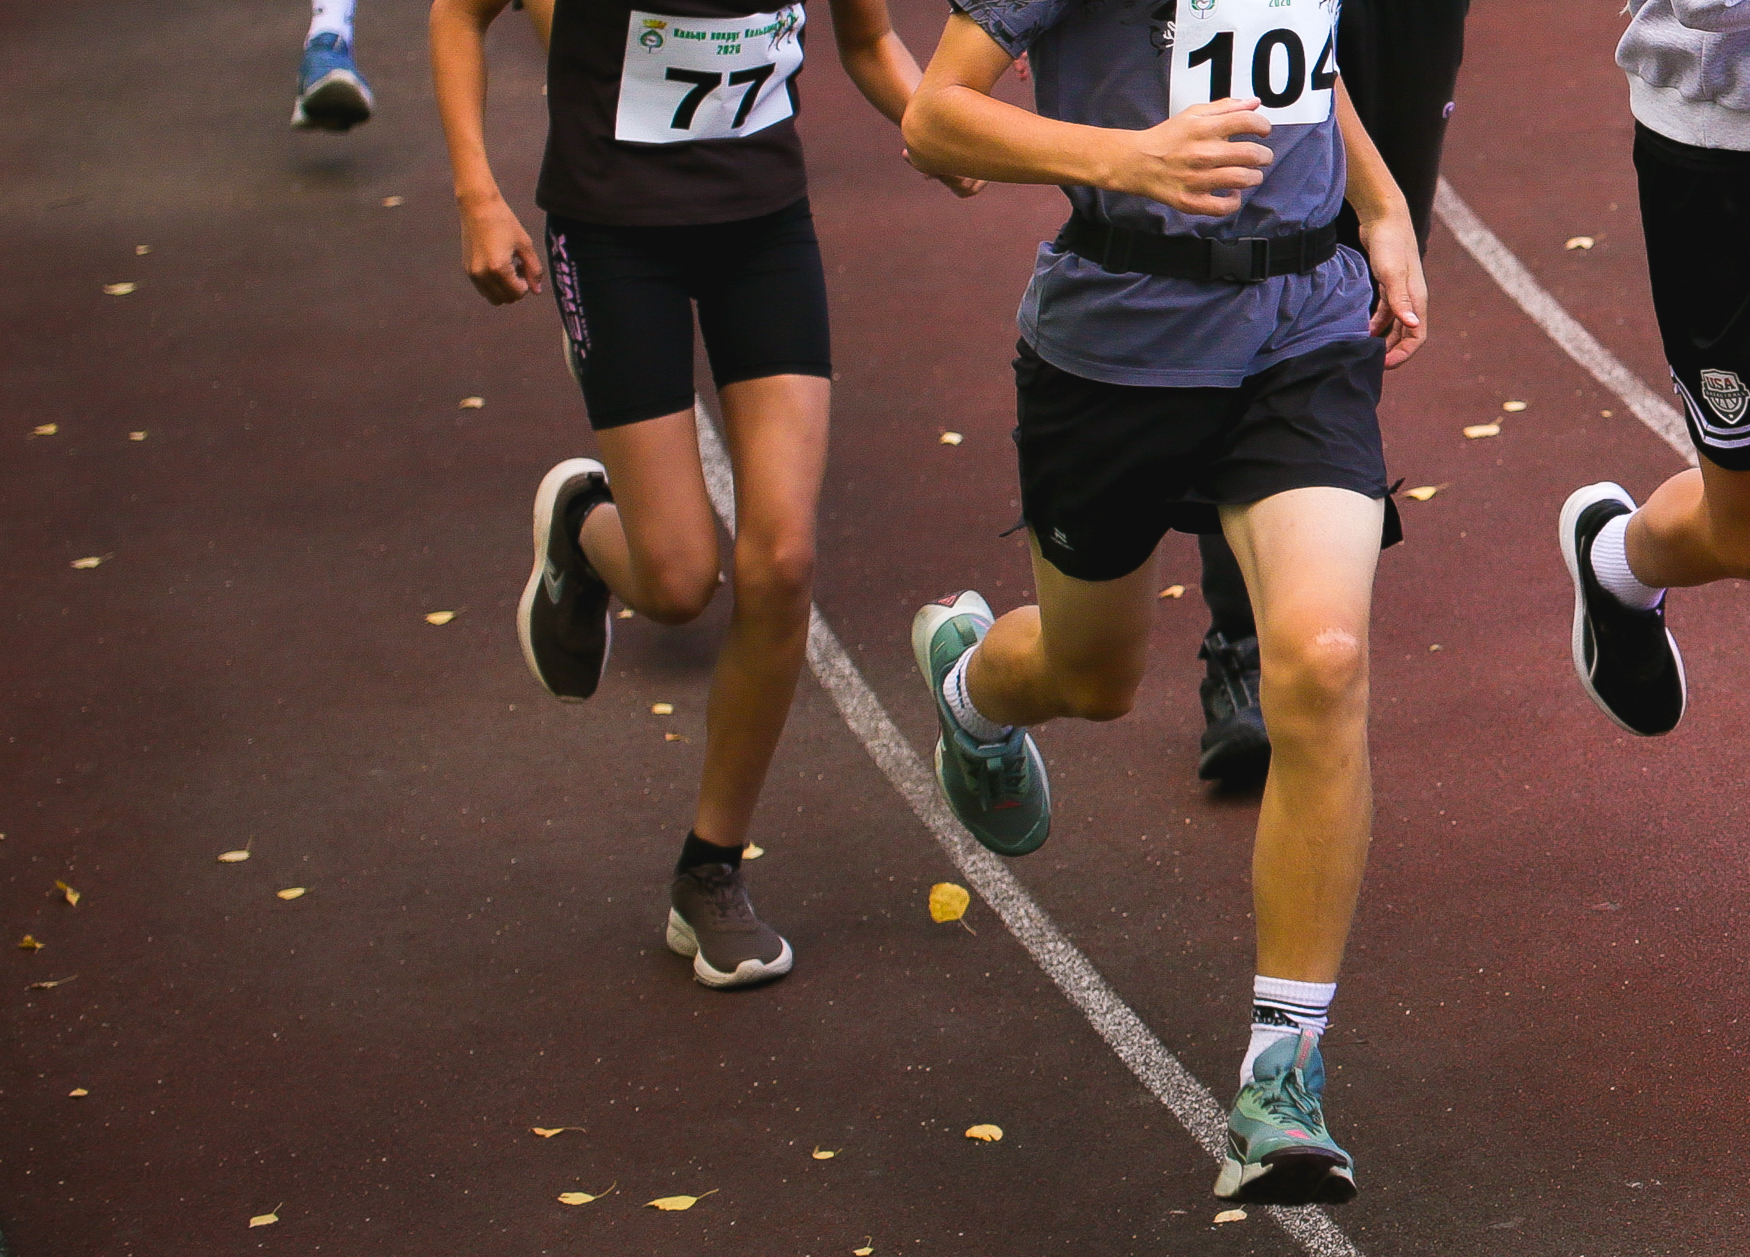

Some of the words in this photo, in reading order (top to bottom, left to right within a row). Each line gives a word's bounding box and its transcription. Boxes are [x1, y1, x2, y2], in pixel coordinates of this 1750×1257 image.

[665, 62, 776, 130] 77
[1187, 24, 1338, 109] 104
[1706, 376, 1737, 390] USA
